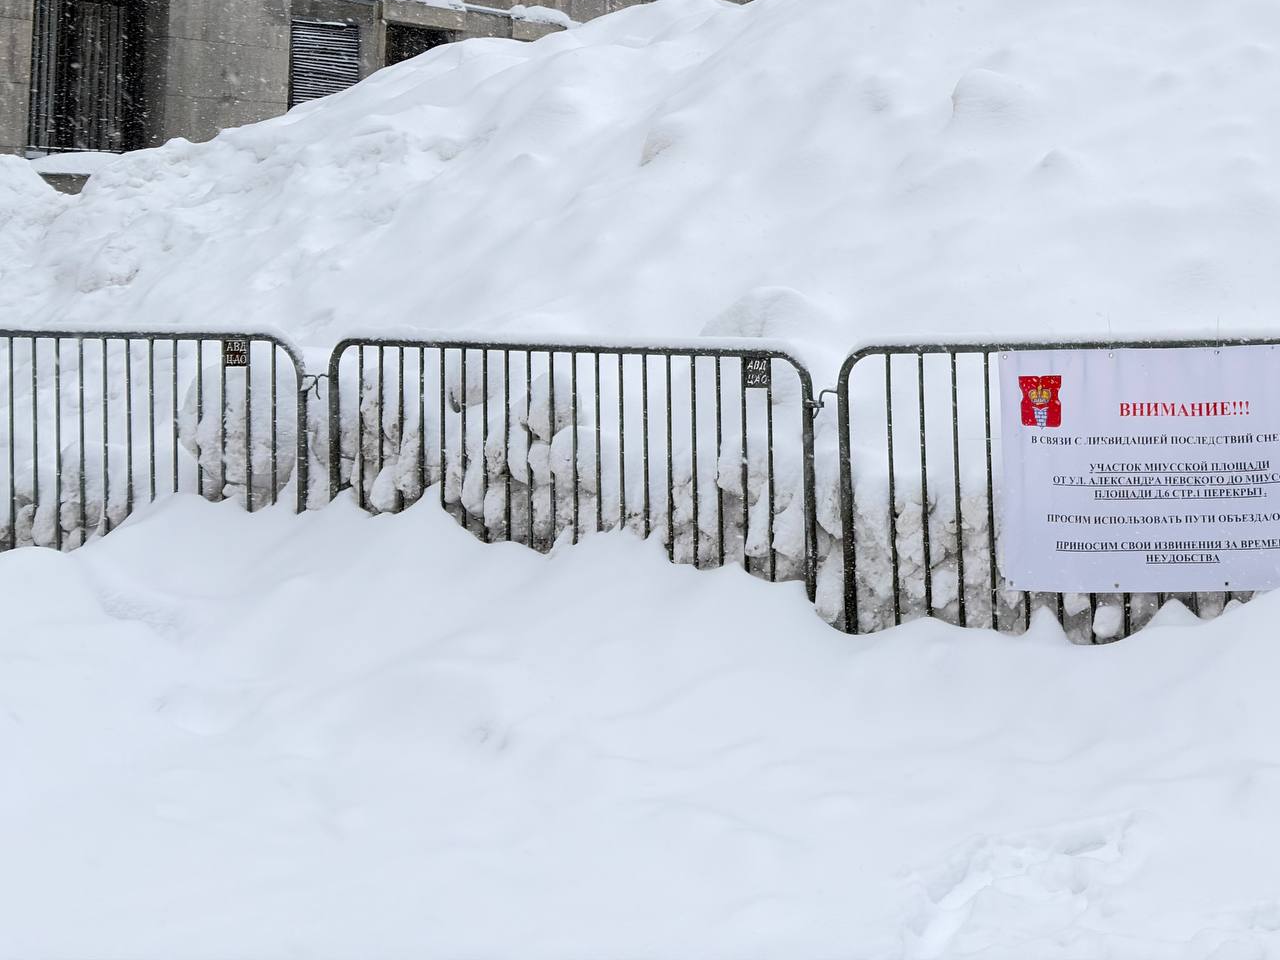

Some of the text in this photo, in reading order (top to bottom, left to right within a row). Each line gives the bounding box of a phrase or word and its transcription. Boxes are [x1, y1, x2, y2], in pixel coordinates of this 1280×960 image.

[226, 341, 247, 353] АВД
[226, 354, 247, 365] ЦАО
[746, 360, 767, 371] АВД
[1119, 400, 1250, 417] ВНИМАНИЕ!!!
[1031, 435, 1038, 444] В
[1039, 436, 1072, 445] СВЯЗИ
[1074, 437, 1082, 445] С
[1084, 434, 1168, 446] ЛИКВИДАЦИЕЙ
[1170, 433, 1253, 445] ПОСЛЕДСТВИЙ
[1089, 460, 1270, 472] УЧАСТОК МИУССКОЙ ПЛОЩАДИ
[1053, 475, 1066, 484] ОТ
[1069, 476, 1087, 485] УЛ.
[1089, 476, 1161, 487] АЛЕКСАНДРА
[1164, 474, 1225, 485] НЕВСКОГО
[1226, 474, 1243, 485] ДО
[1094, 489, 1152, 499] ПЛОЩАДИ
[1154, 490, 1170, 499] Д.6
[1172, 489, 1201, 498] СТР.1
[1046, 514, 1091, 524] ПРОСИМ
[1093, 514, 1183, 525] ИСПОЛЬЗОВАТЬ
[1184, 514, 1216, 524] ПУТИ
[1056, 540, 1118, 551] ПРИНОСИМ
[1120, 541, 1152, 550] СВОИ
[1154, 540, 1222, 550] ИЗВИНЕНИЯ
[1225, 540, 1239, 549] ЗА
[1145, 553, 1221, 564] НЕУДОБСТВА
